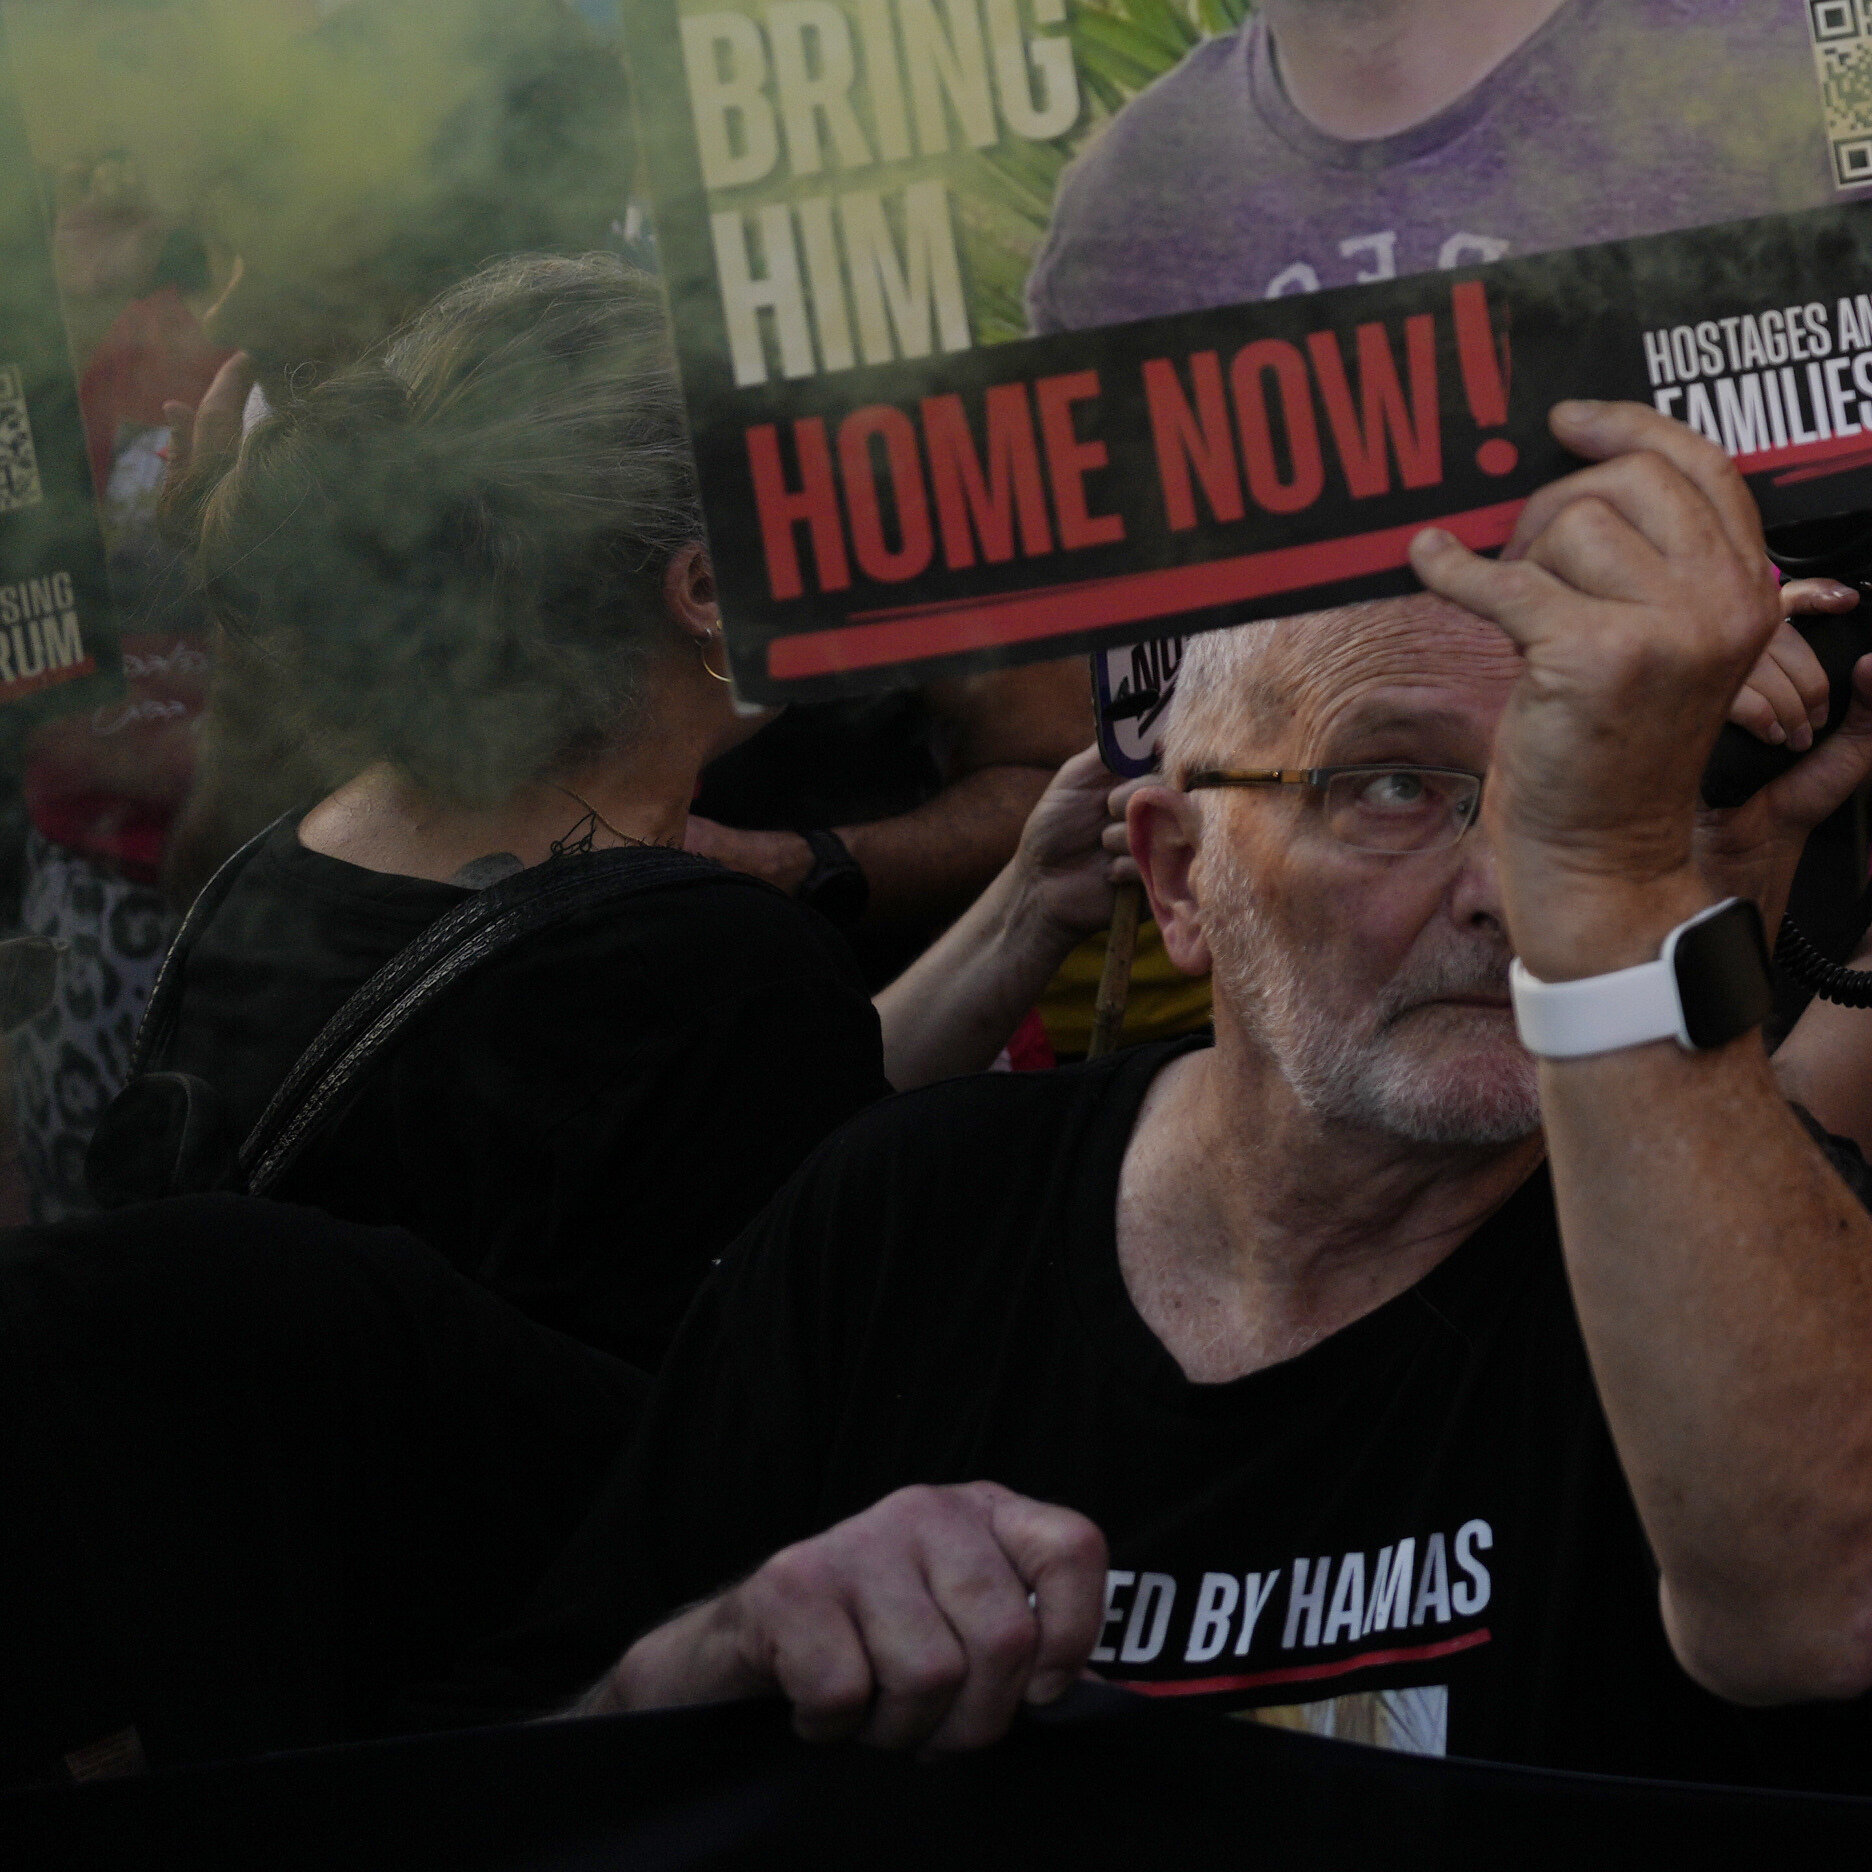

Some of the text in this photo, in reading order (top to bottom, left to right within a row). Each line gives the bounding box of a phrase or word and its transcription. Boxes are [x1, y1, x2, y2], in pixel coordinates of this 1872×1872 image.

[713, 181, 972, 386] HIM
[1643, 301, 1832, 386] HOSTAGES
[746, 280, 1519, 602] HOME NOW!
[1094, 1518, 1493, 1664] ED BY HAMAS
